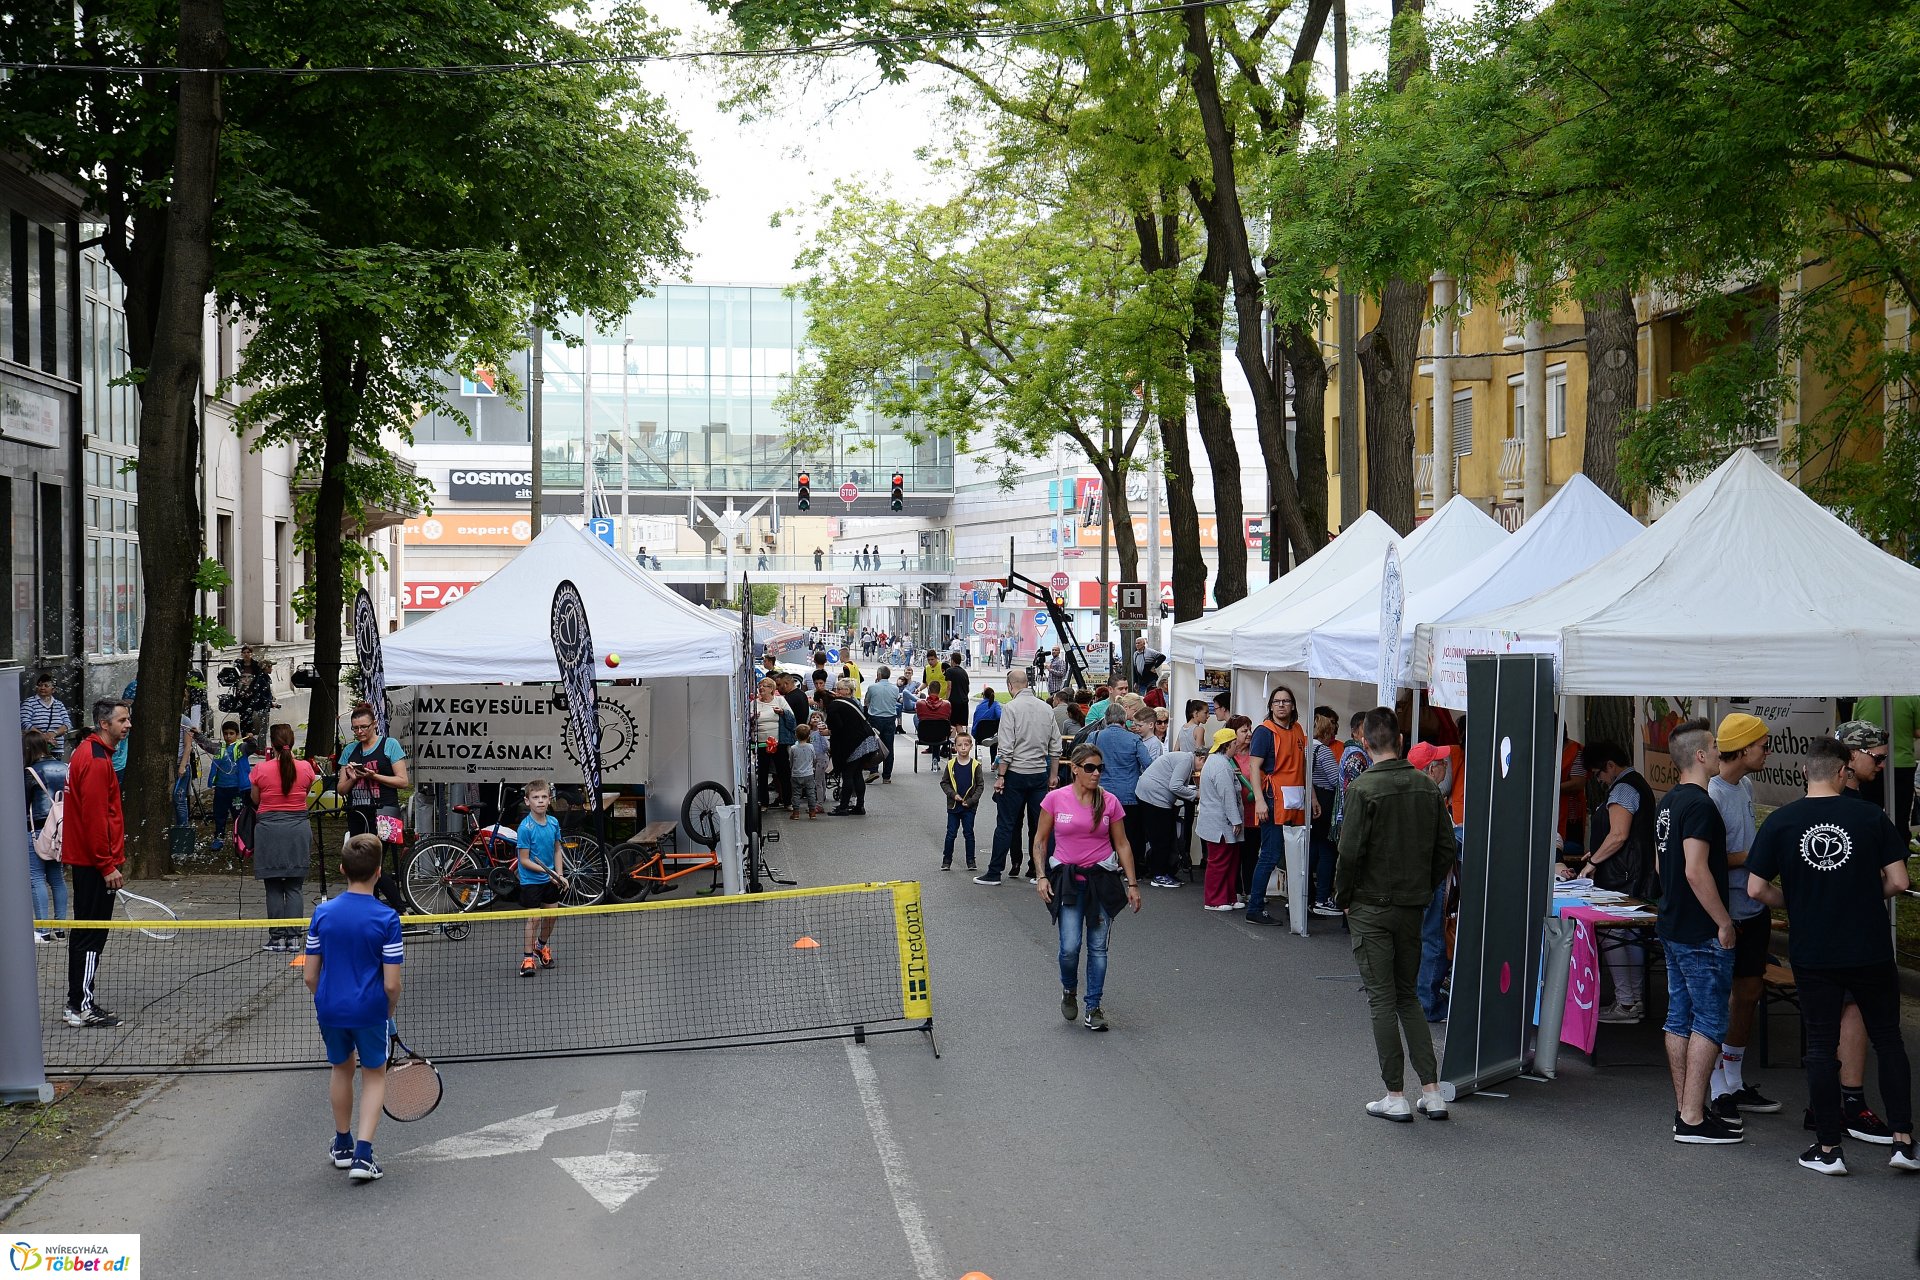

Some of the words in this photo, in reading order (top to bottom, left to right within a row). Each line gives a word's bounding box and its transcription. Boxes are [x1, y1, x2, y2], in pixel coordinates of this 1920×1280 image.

[841, 488, 857, 497] STOP
[403, 524, 420, 534] ert
[457, 525, 510, 536] expert
[595, 523, 609, 538] P
[1052, 577, 1068, 586] STOP
[417, 697, 446, 714] MX
[450, 695, 554, 715] EGYESÜLET
[1753, 702, 1792, 721] megyei
[417, 717, 488, 737] ZZÁNK!
[904, 901, 925, 978] Tretorn
